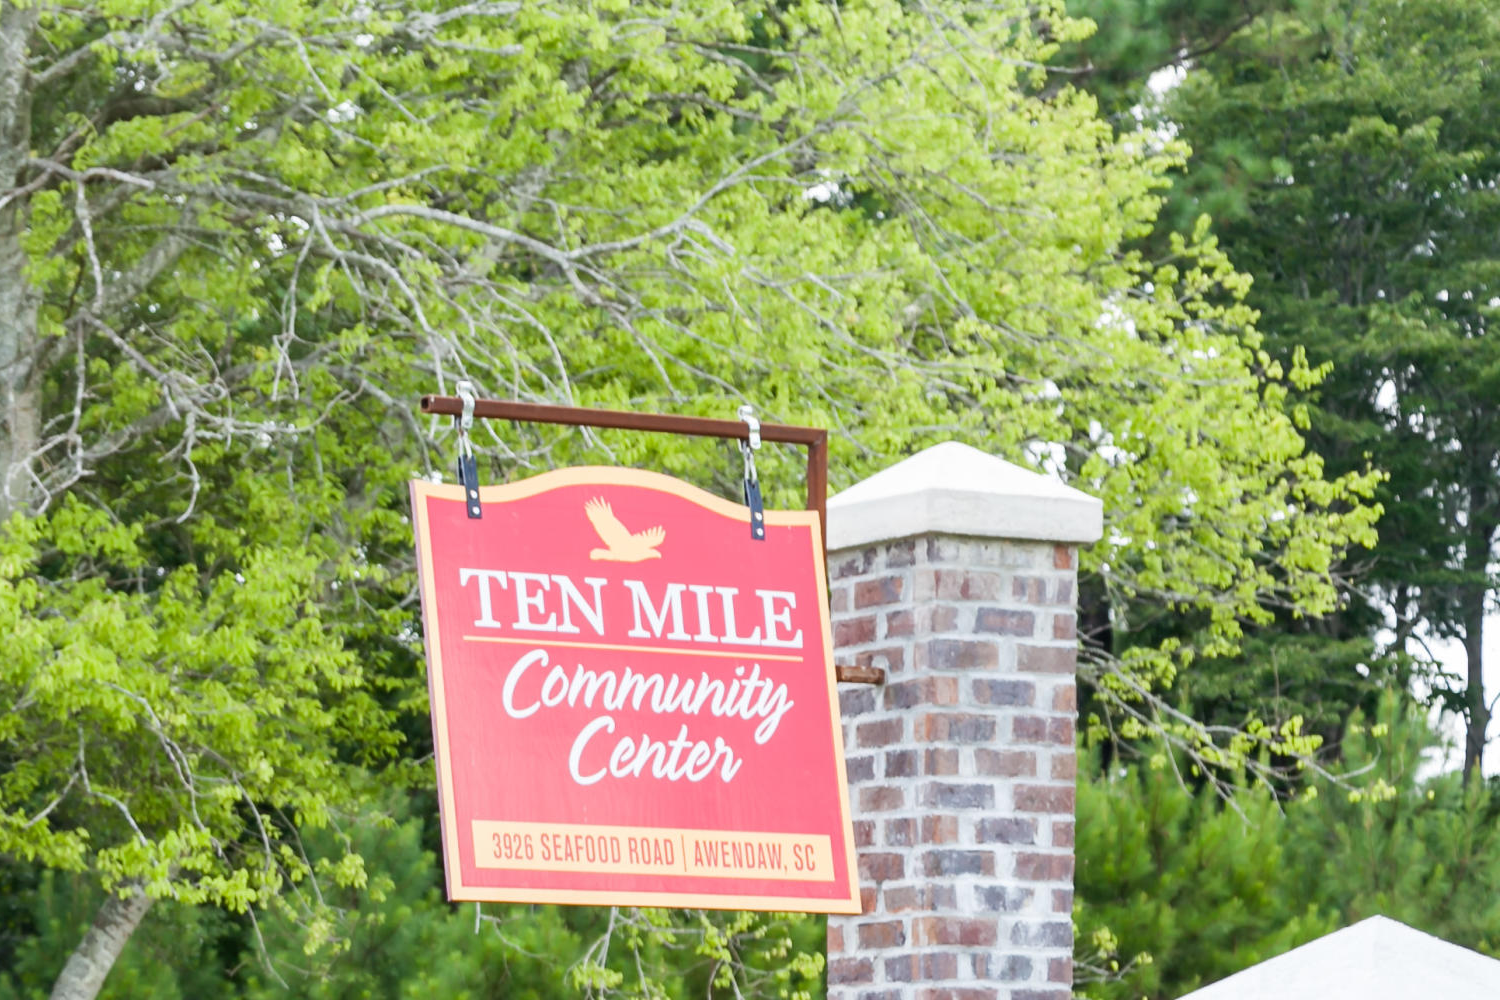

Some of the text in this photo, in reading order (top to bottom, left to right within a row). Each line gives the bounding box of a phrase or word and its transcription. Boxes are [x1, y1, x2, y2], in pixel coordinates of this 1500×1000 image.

[460, 569, 803, 648] TEN MILE
[502, 649, 794, 744] Community
[569, 716, 742, 785] Center
[492, 833, 816, 874] 3926 SEAFOOD ROAD AWENDAW, SC
